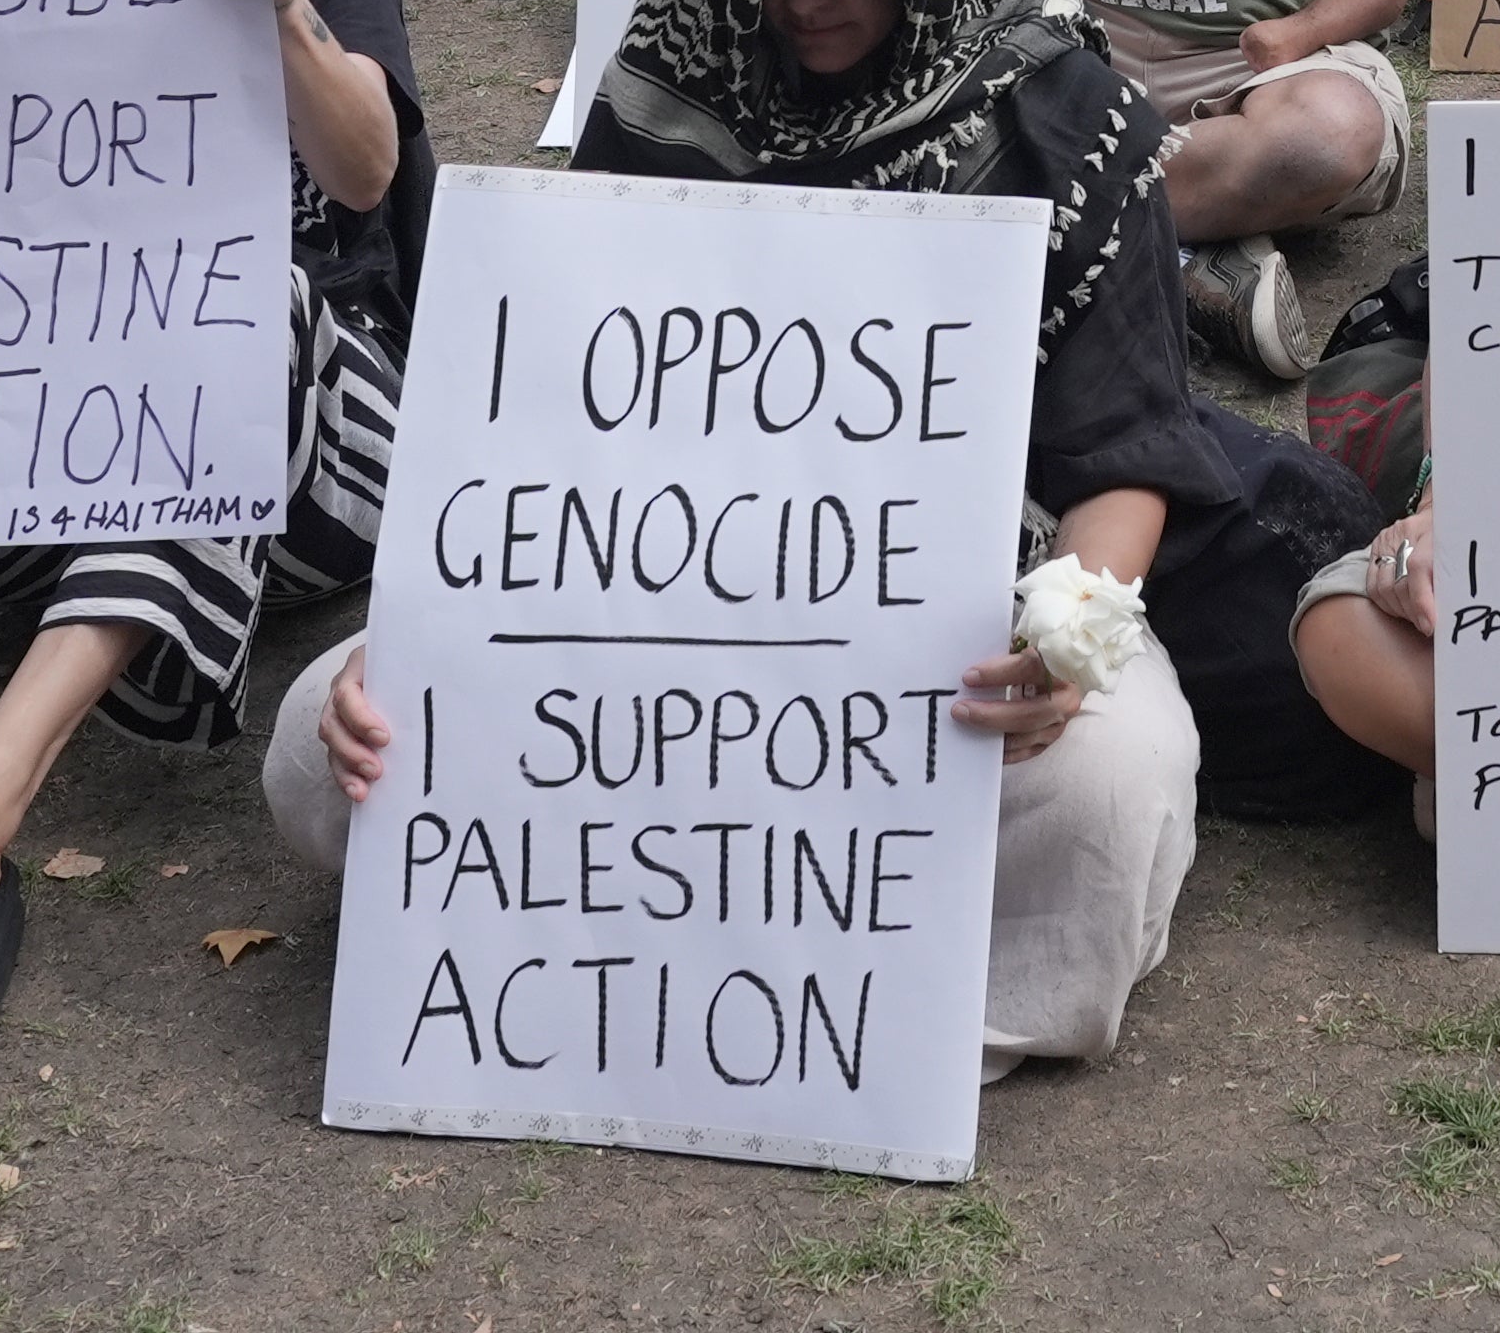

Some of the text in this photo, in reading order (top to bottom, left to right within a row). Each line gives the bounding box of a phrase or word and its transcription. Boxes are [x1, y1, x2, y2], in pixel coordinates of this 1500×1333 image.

[1464, 138, 1475, 197] I
[487, 293, 973, 443] I OPPOSE
[8, 502, 41, 538] IS
[434, 477, 928, 610] GENOCIDE
[1468, 540, 1478, 599] I
[422, 687, 959, 797] I SUPPORT
[402, 811, 936, 935] PALESTINE
[401, 947, 874, 1093] ACTION
